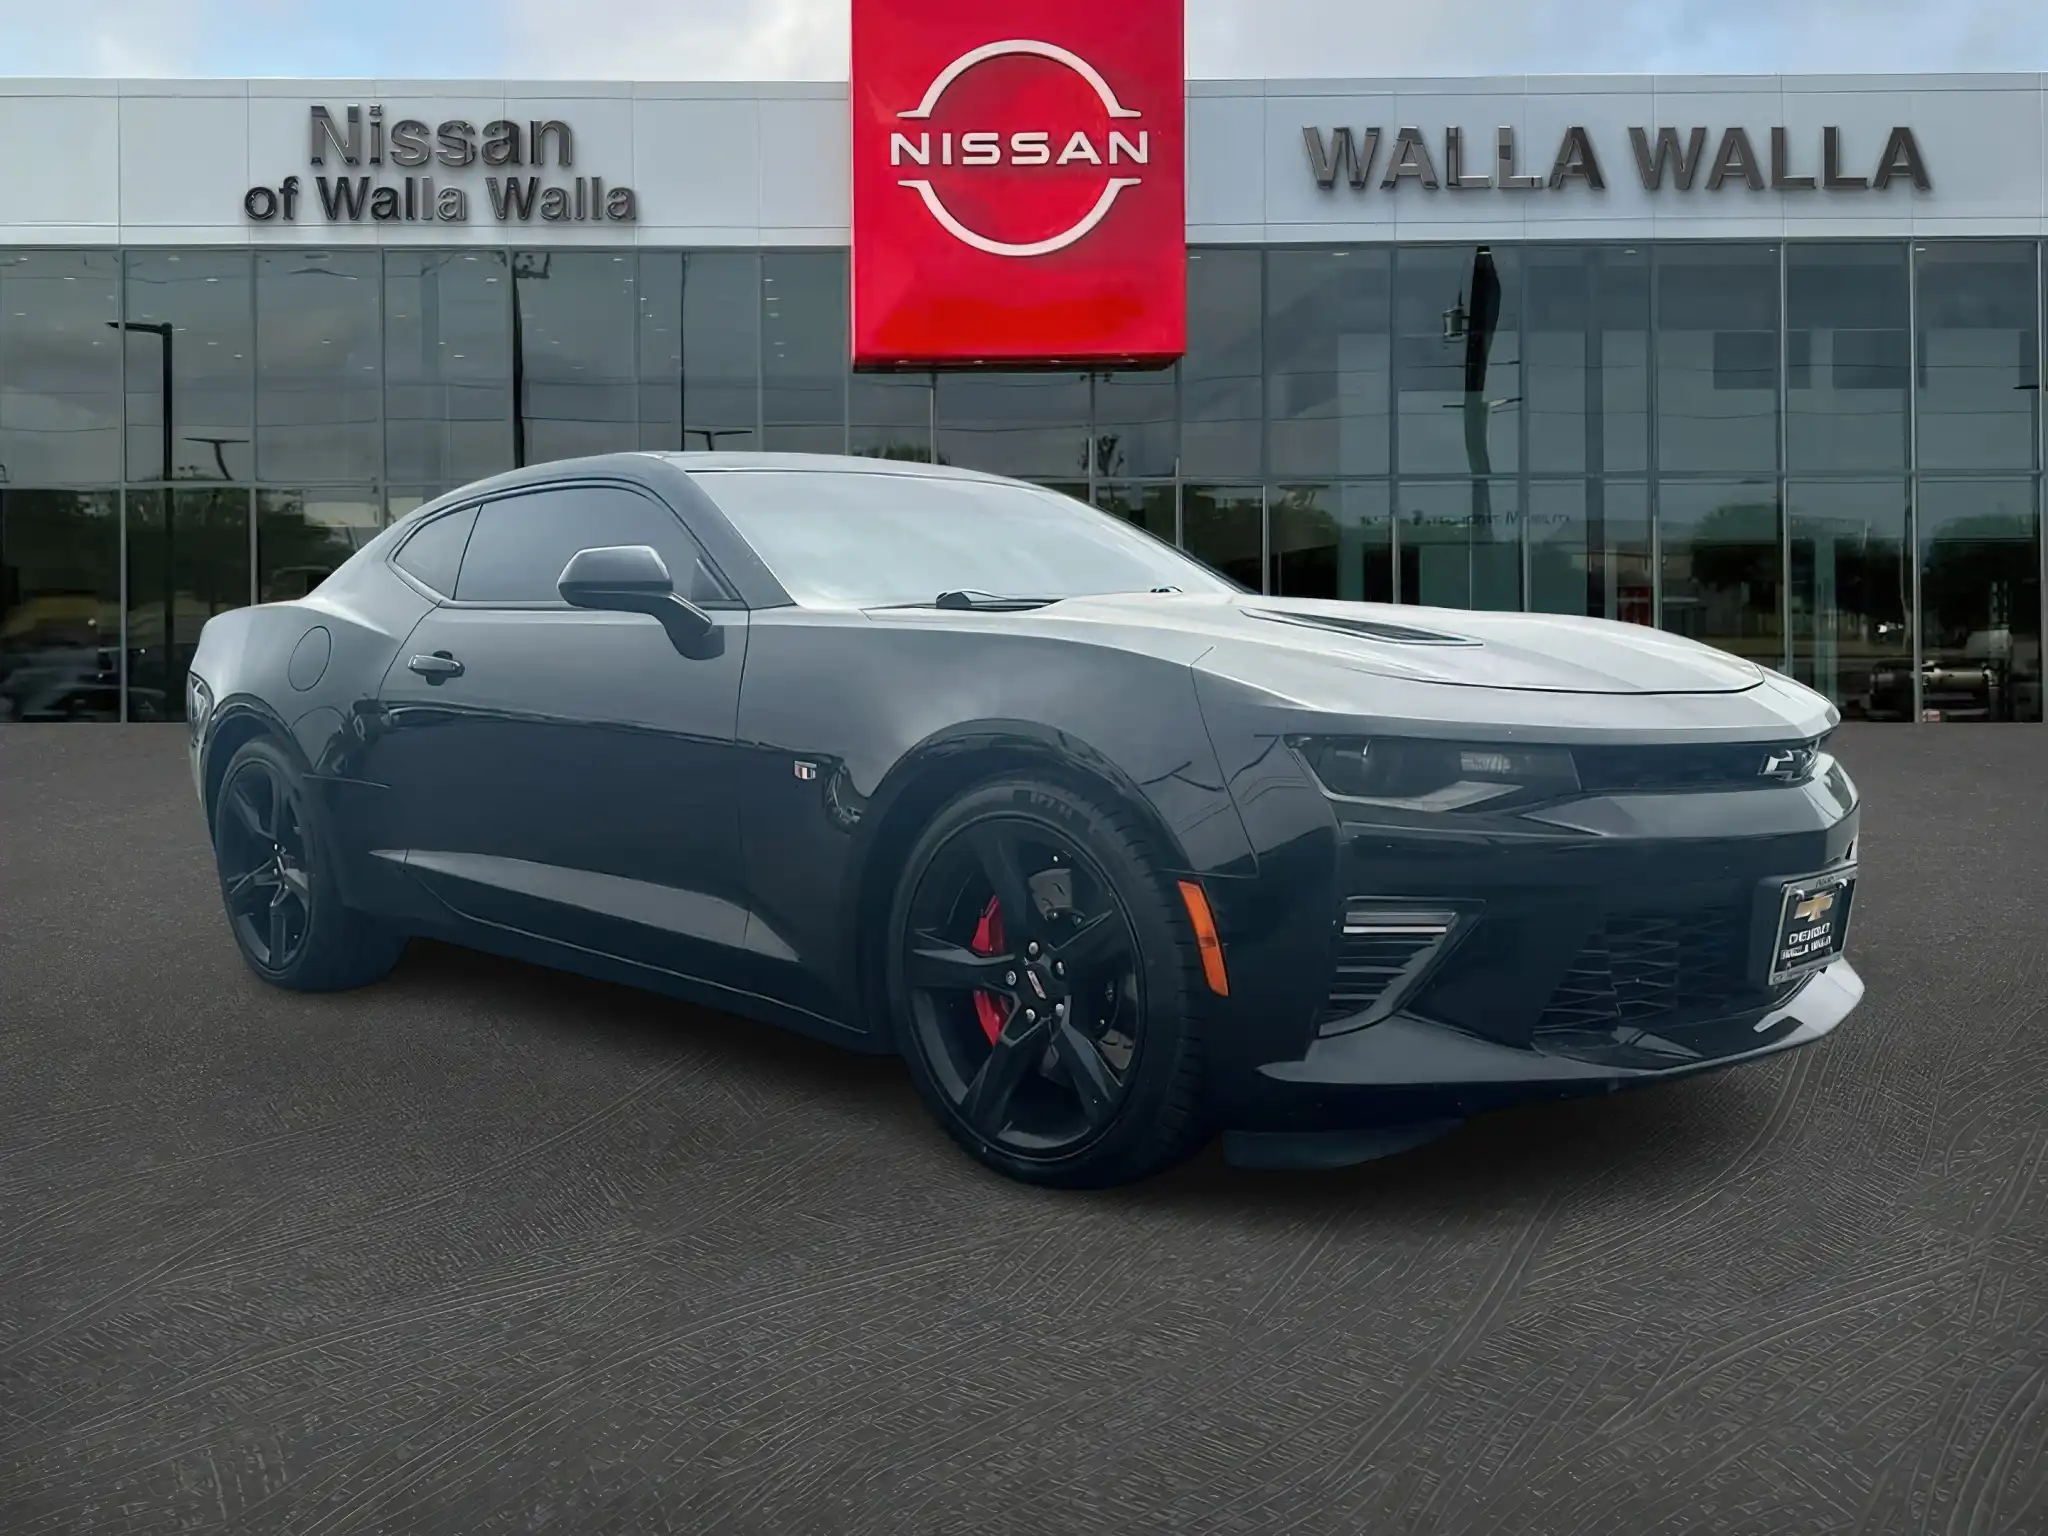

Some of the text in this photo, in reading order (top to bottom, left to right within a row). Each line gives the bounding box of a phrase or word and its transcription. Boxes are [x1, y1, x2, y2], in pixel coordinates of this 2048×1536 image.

[310, 104, 572, 166] Nissan
[890, 131, 1148, 165] NISSAN
[1303, 126, 1932, 190] WALLA WALLA
[244, 175, 637, 221] of Walla Walla
